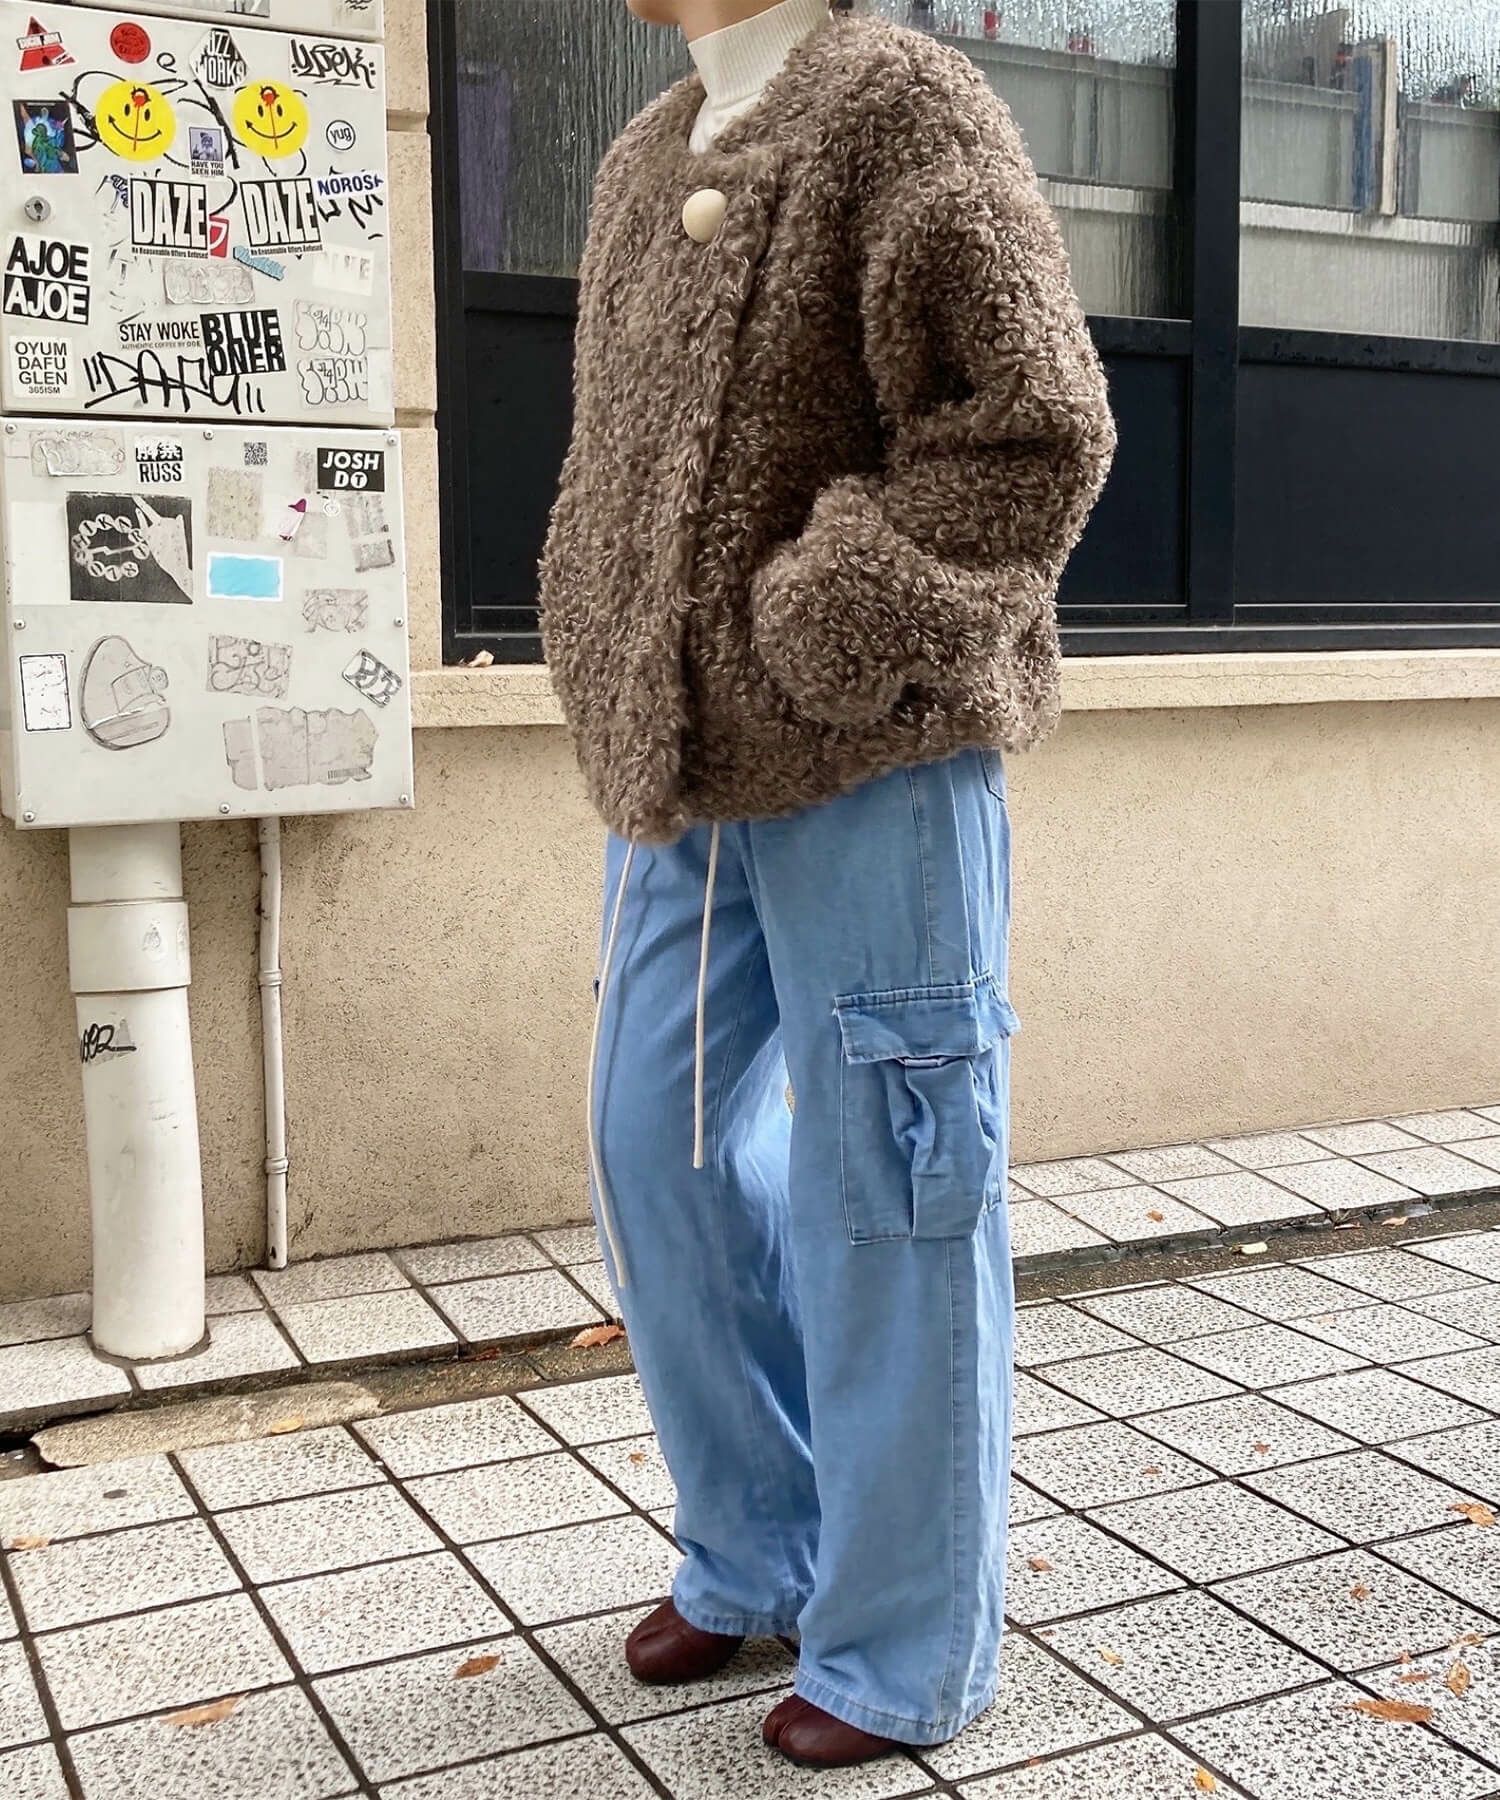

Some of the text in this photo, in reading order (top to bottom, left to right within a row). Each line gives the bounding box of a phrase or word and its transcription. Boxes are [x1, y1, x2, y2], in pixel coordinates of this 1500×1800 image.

[330, 127, 352, 144] yug
[191, 160, 208, 168] HAVE
[131, 180, 207, 248] DAZE
[241, 179, 320, 246] DAZE
[6, 236, 89, 281] AJOE
[5, 277, 88, 323] AJOE
[119, 321, 200, 342] STAY WOKE
[200, 310, 280, 346] BLUE
[15, 341, 67, 356] OYUM
[18, 356, 66, 370] DAFU
[206, 342, 286, 376] ONER
[19, 371, 68, 385] GLEN
[322, 451, 380, 470] JOSH
[139, 462, 182, 482] RUSS
